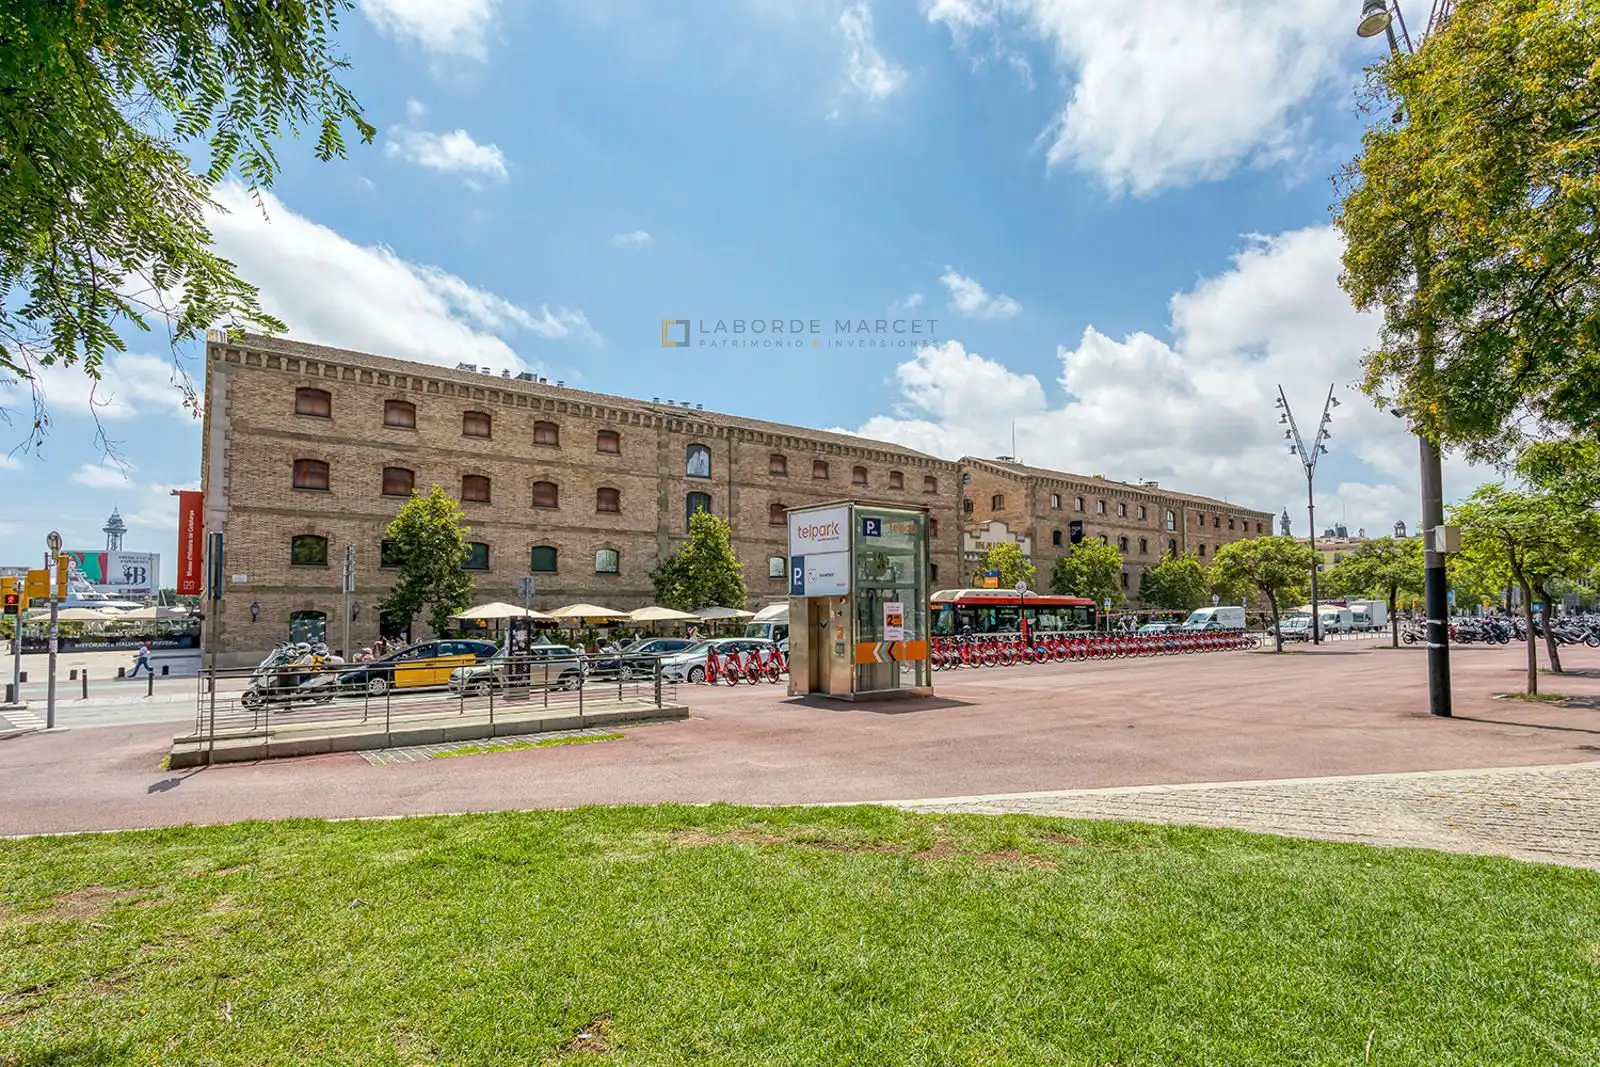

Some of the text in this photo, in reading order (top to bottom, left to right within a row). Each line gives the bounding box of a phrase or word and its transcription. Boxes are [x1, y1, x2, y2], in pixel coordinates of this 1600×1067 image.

[798, 522, 840, 541] telpark
[866, 520, 876, 535] P
[793, 567, 802, 585] P
[887, 614, 894, 626] 2
